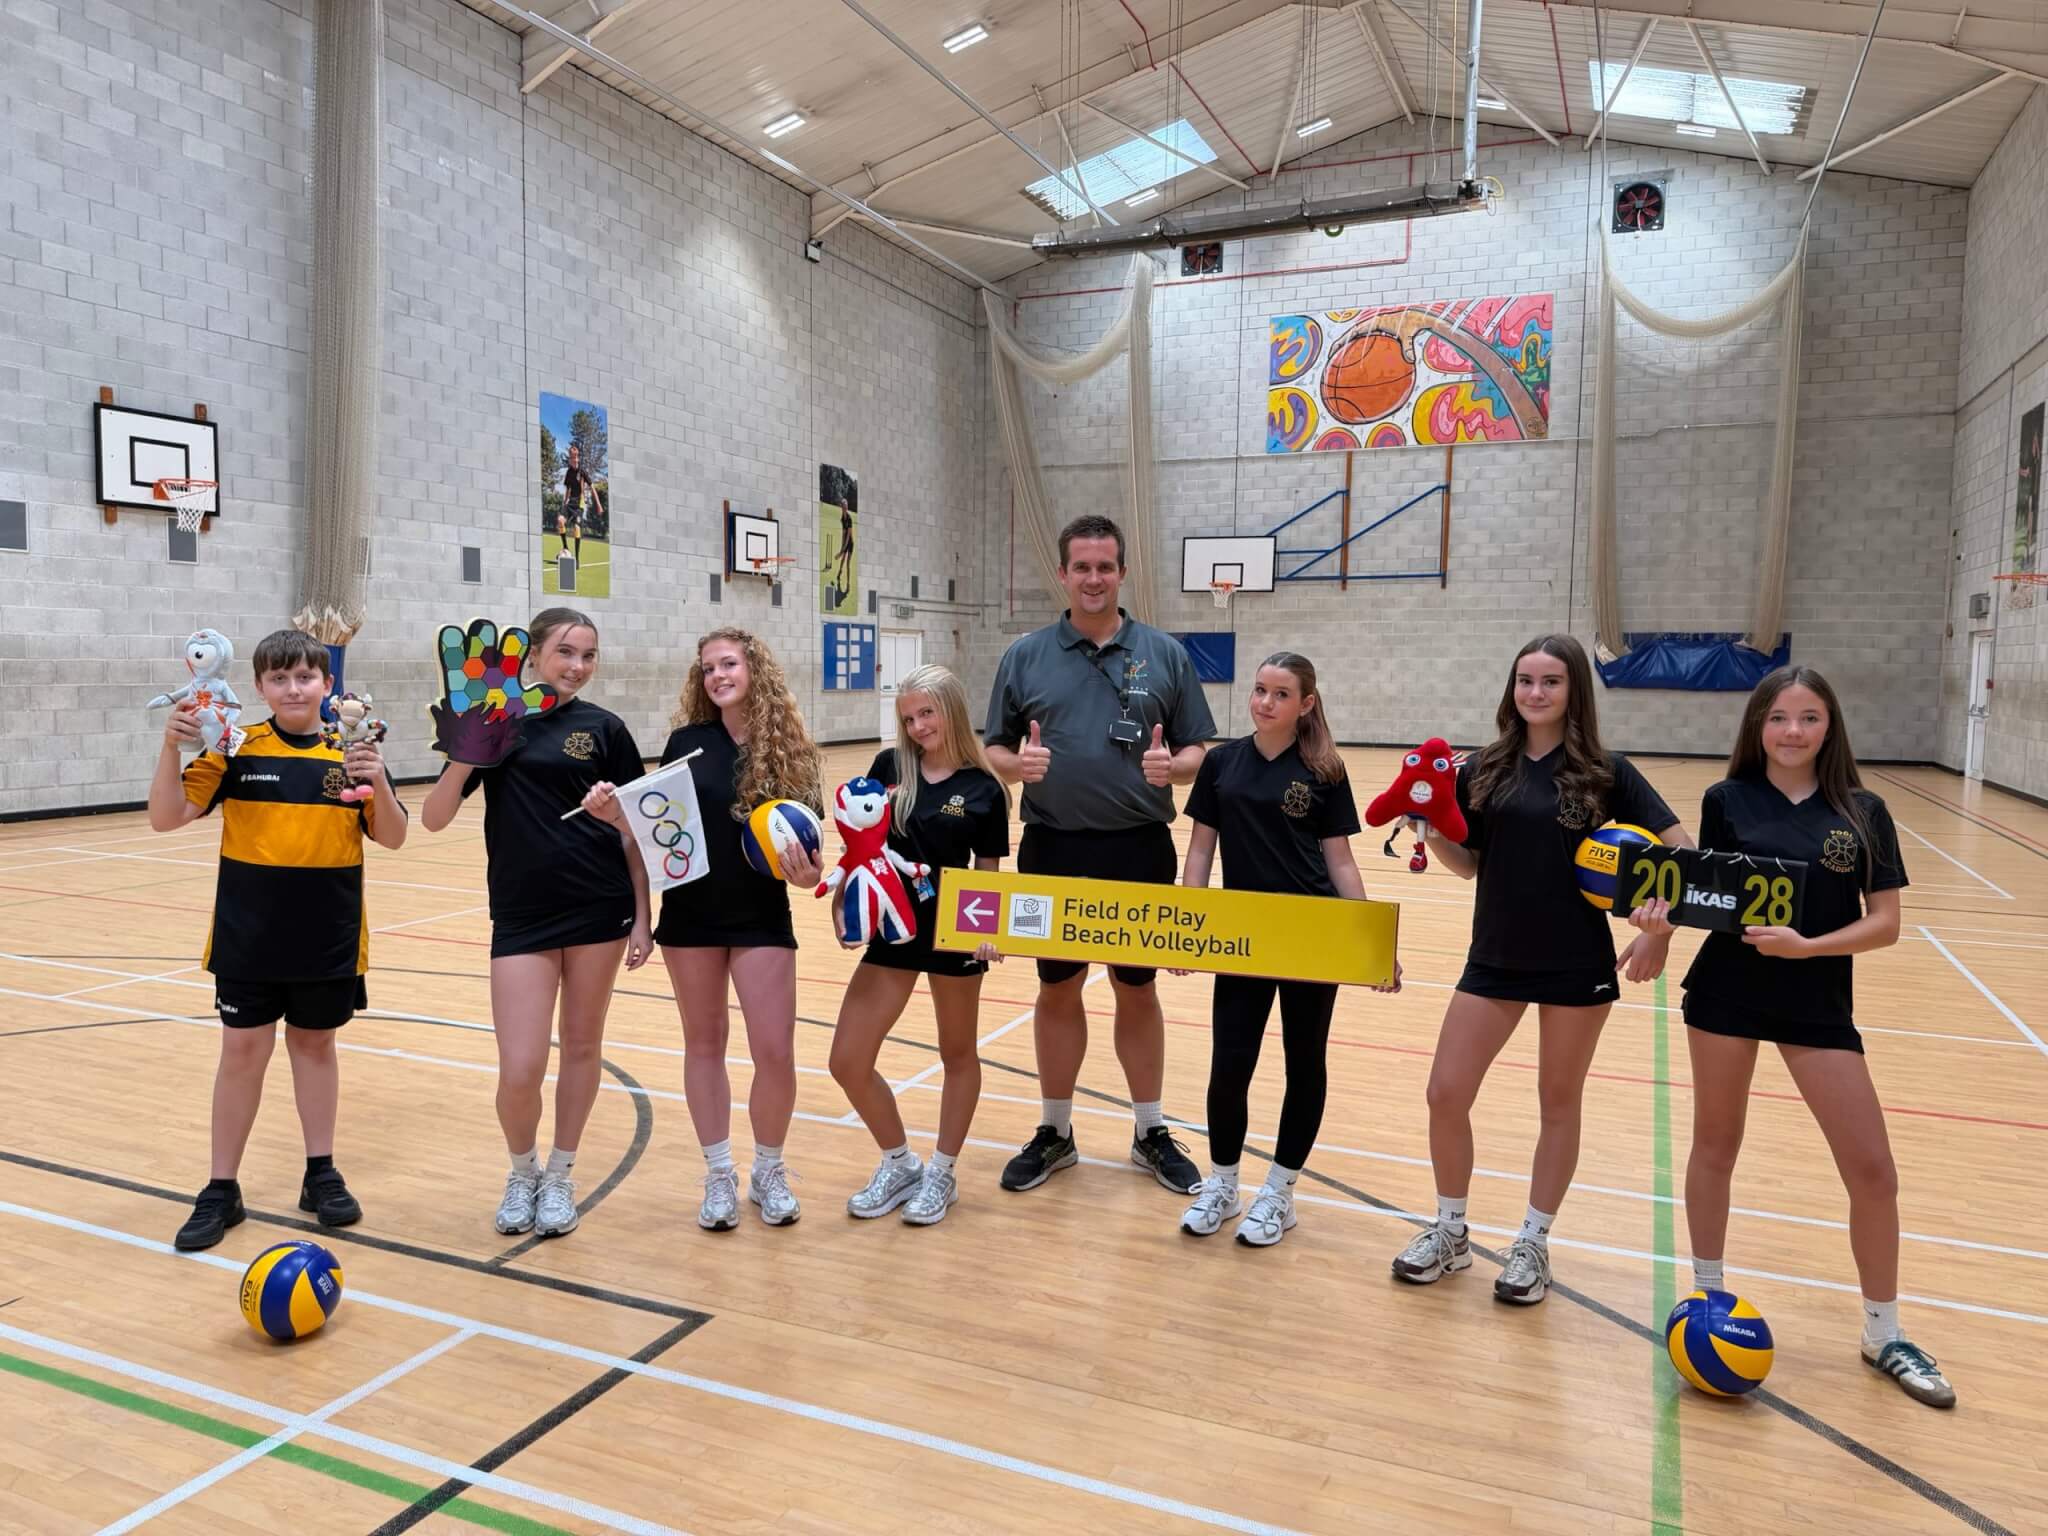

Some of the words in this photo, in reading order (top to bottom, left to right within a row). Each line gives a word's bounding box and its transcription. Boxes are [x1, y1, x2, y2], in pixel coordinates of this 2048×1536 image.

[1629, 858, 1681, 910] 20
[1740, 874, 1794, 926] 28
[1064, 898, 1120, 921] Field
[1127, 903, 1151, 922] of
[1157, 905, 1207, 932] Play
[1062, 923, 1131, 947] Beach
[1138, 928, 1252, 958] Volleyball
